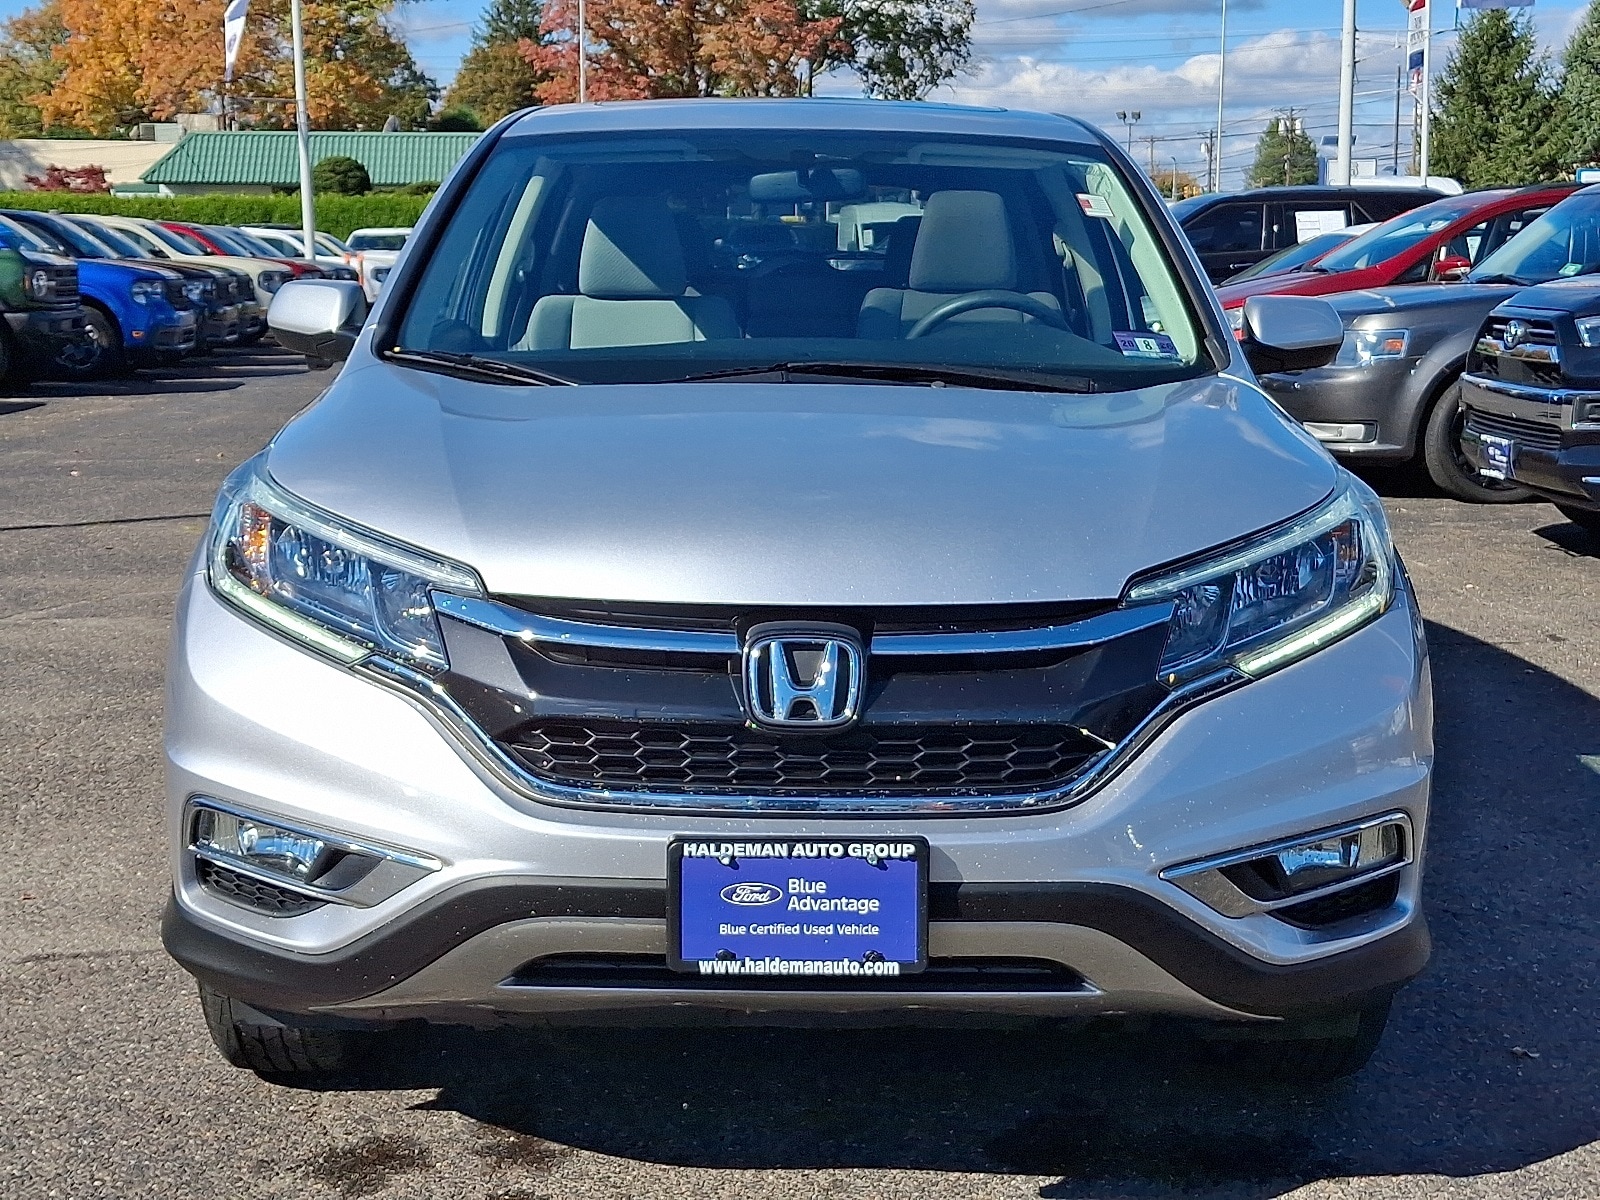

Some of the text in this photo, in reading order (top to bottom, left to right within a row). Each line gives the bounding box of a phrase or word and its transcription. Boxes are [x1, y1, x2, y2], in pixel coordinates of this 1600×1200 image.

[1143, 340, 1153, 350] 8
[683, 843, 916, 858] HALDEMAN AUTO GROUP
[788, 878, 827, 894] Blue
[787, 896, 880, 914] Advantage
[719, 923, 880, 935] Blue Certified Used Vehicle
[699, 956, 899, 975] www.haldemanauto.com
